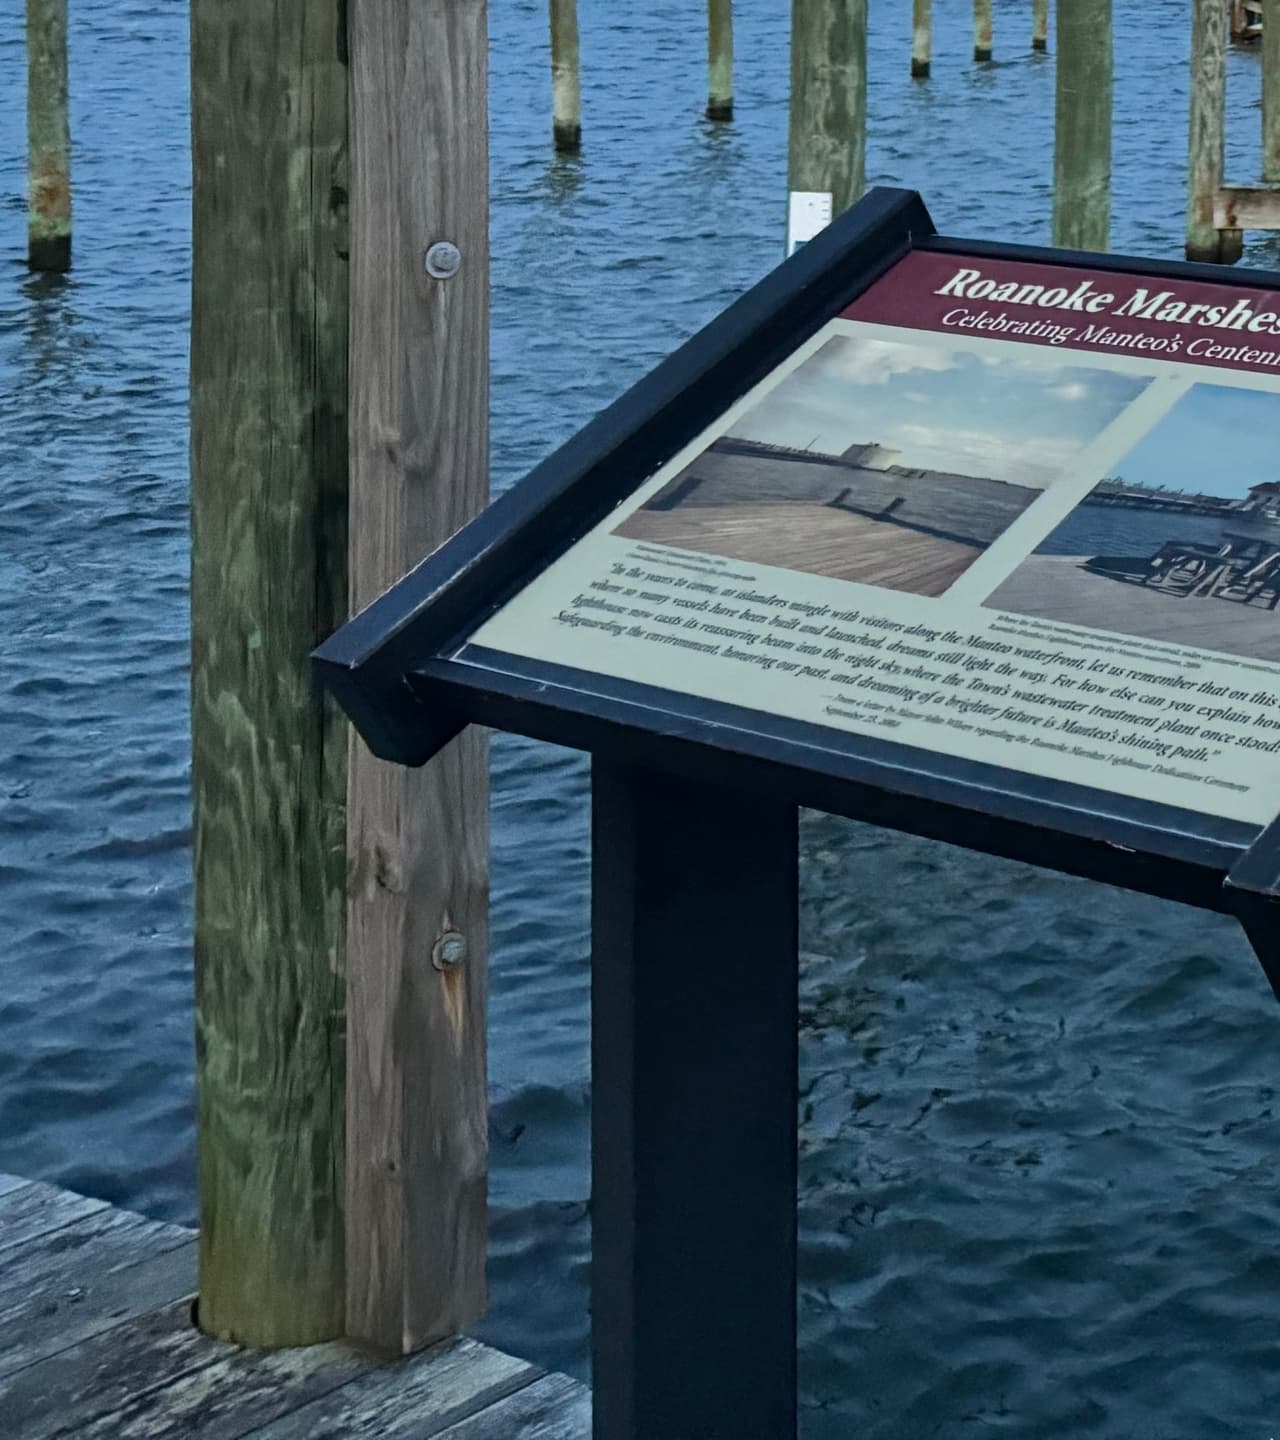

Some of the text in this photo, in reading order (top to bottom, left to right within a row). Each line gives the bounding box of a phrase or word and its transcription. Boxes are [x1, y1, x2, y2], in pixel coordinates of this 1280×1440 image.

[934, 269, 1114, 312] Roanoke
[942, 309, 1075, 342] Celebrating
[1074, 325, 1183, 352] Manteo's
[553, 609, 628, 636] Safeguarding
[626, 625, 647, 637] the
[644, 632, 721, 654] environment,
[721, 644, 779, 669] honoring
[776, 660, 802, 671] our
[830, 673, 863, 684] and
[857, 675, 921, 701] dreaming
[917, 690, 940, 704] of
[933, 695, 946, 703] a
[944, 693, 1001, 715] brighter
[992, 705, 1044, 725] future
[1042, 715, 1057, 728] is
[1055, 718, 1119, 741] Manteo's
[1117, 732, 1174, 756] shining
[625, 566, 646, 577] the
[644, 572, 675, 584] years
[674, 577, 689, 586] to
[720, 588, 738, 596] as
[734, 589, 790, 607] islanders
[788, 601, 831, 616] mingle
[830, 610, 860, 622] with
[859, 616, 905, 631] visitors
[903, 623, 943, 642] along
[940, 630, 964, 643] the
[961, 634, 1014, 653] Manteo
[1014, 647, 1087, 670] waterfront,
[1086, 658, 1111, 672] let
[1107, 665, 1127, 676] us
[1125, 669, 1199, 689] remember
[1196, 680, 1230, 696] that
[1228, 690, 1250, 700] on
[1249, 690, 1279, 706] this
[628, 608, 654, 618] now
[654, 613, 684, 625] casts
[682, 616, 700, 628] its
[699, 623, 761, 645] reassuring
[760, 632, 796, 649] beam
[795, 641, 823, 655] into
[822, 647, 845, 660] the
[844, 654, 881, 668] night
[941, 672, 965, 686] the
[966, 677, 1011, 696] Town's
[1011, 689, 1090, 712] wastewater
[1088, 704, 1160, 727] treatment
[1154, 717, 1201, 735] plant
[1200, 729, 1236, 743] once
[638, 591, 671, 604] many
[673, 597, 710, 611] vessels
[708, 602, 740, 616] have
[738, 607, 769, 623] been
[768, 614, 801, 629] built
[798, 624, 830, 635] and
[824, 625, 887, 649] launched,
[886, 639, 936, 658] dreams
[933, 651, 966, 664] still
[961, 654, 995, 671] light
[994, 661, 1019, 676] the
[1019, 669, 1048, 684] way.
[1050, 673, 1078, 687] For
[1077, 677, 1110, 693] how
[1109, 685, 1138, 700] else
[1138, 694, 1166, 706] can
[1162, 699, 1196, 712] you
[1196, 706, 1252, 723] explain
